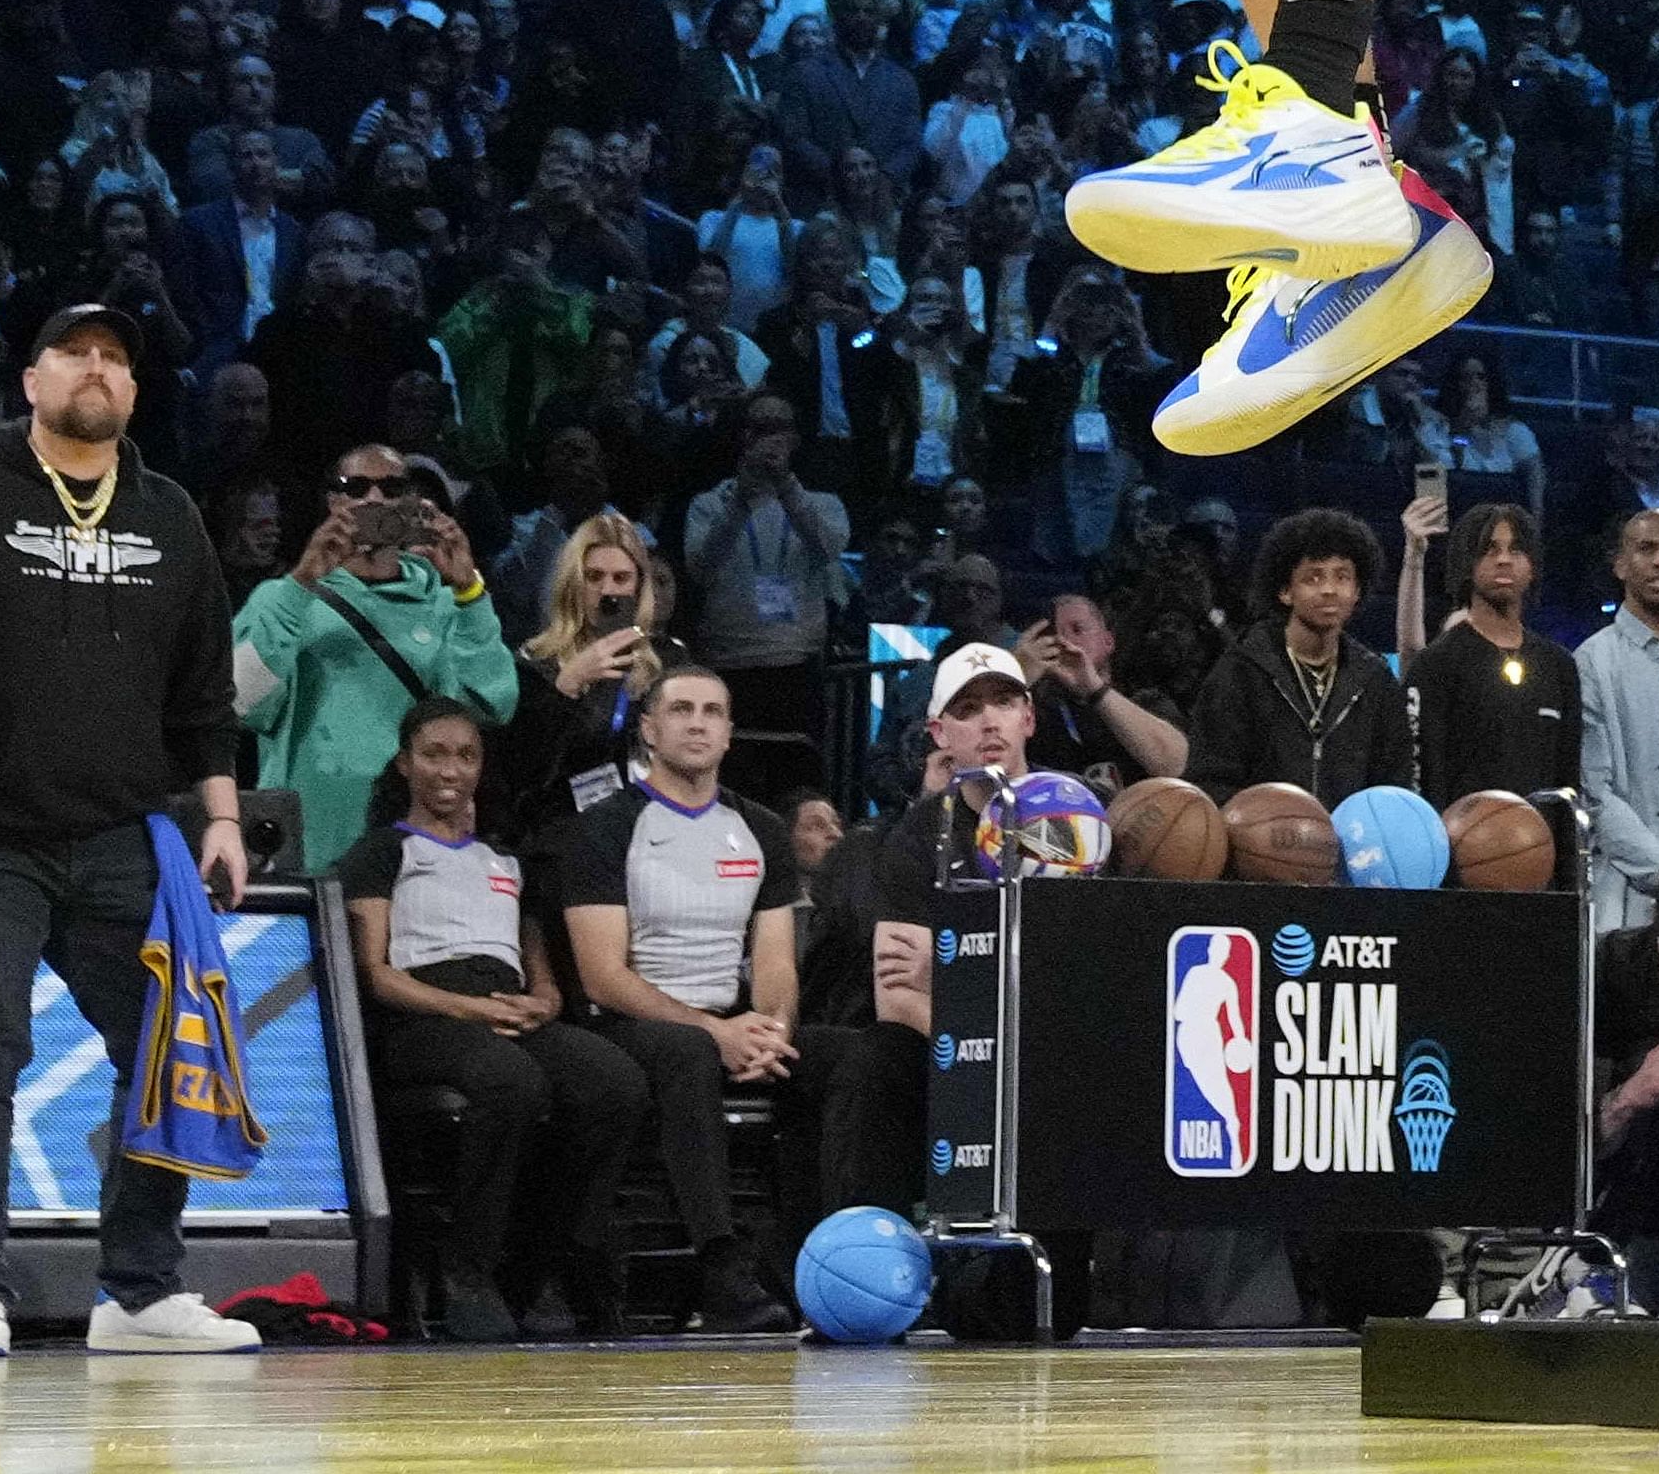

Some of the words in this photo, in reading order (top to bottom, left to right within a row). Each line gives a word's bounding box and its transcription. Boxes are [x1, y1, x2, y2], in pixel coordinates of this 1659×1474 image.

[958, 931, 997, 956] AT&T
[1320, 935, 1398, 969] AT&T
[1273, 981, 1398, 1077] SLAM
[955, 1037, 995, 1062] AT&T
[1178, 1119, 1223, 1160] NBA
[1272, 1078, 1397, 1174] DUNK
[954, 1143, 994, 1169] AT&T
